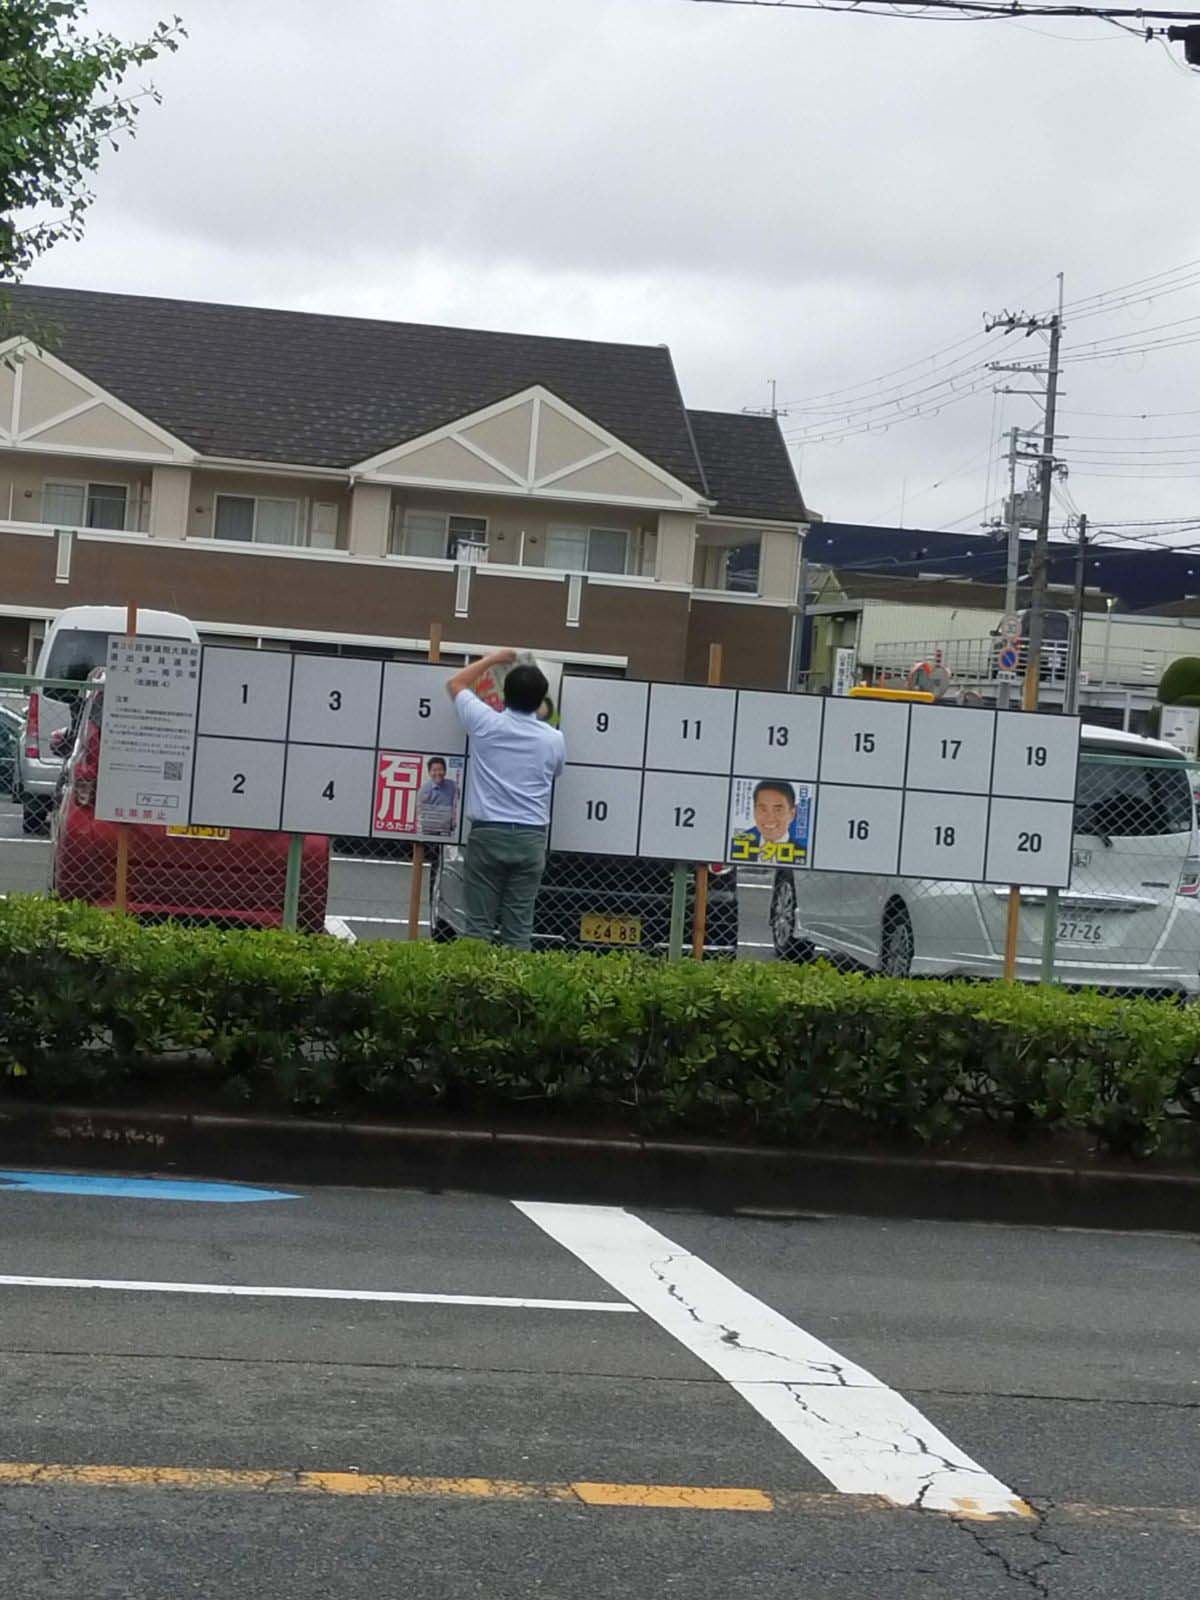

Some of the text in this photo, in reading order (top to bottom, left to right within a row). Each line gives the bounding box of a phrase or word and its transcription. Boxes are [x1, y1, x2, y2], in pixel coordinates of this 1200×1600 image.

[240, 684, 249, 704] 1
[328, 690, 342, 711] 3
[417, 697, 432, 718] 5
[596, 712, 610, 733] 9
[682, 719, 702, 740] 11
[767, 726, 789, 747] 13
[854, 733, 876, 753] 15
[940, 739, 962, 760] 17
[1026, 746, 1048, 767] 19
[232, 773, 246, 794] 2
[321, 780, 336, 801] 4
[377, 755, 421, 824] 石川
[586, 800, 608, 822] 10
[674, 806, 696, 828] 12
[847, 820, 870, 841] 16
[934, 826, 956, 847] 18
[732, 839, 806, 863] コータロー
[1017, 832, 1042, 853] 20
[1058, 922, 1102, 941] 27-26
